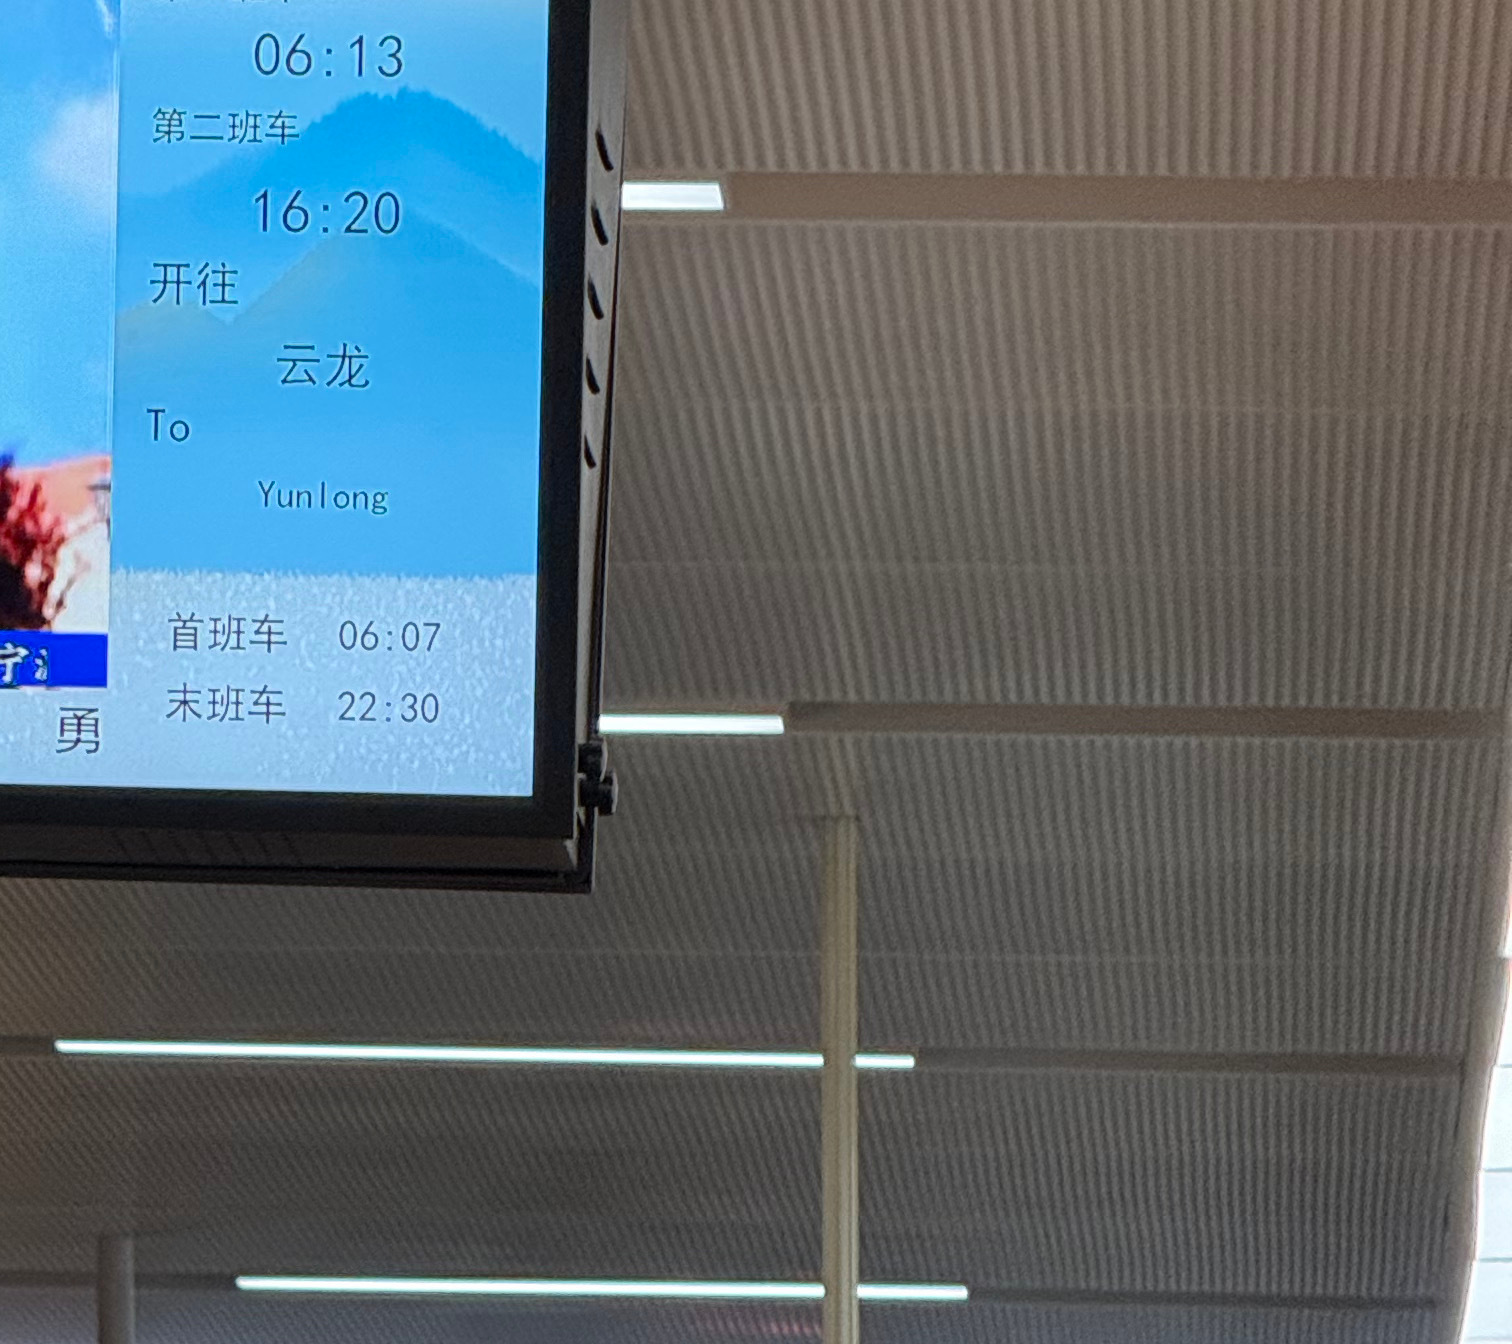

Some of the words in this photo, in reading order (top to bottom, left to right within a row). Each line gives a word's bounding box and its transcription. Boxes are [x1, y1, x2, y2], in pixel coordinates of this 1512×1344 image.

[255, 33, 402, 77] 06:13
[152, 107, 300, 146] 第二班车
[255, 189, 399, 234] 16:20
[150, 262, 238, 306] 开往
[277, 343, 369, 388] 云龙
[147, 408, 189, 442] To
[258, 481, 388, 514] Yunlong
[168, 612, 287, 653] 首班车
[339, 620, 440, 652] 06:07
[166, 682, 286, 724] 末班车
[338, 691, 439, 723] 22:30
[56, 707, 100, 754] 勇
